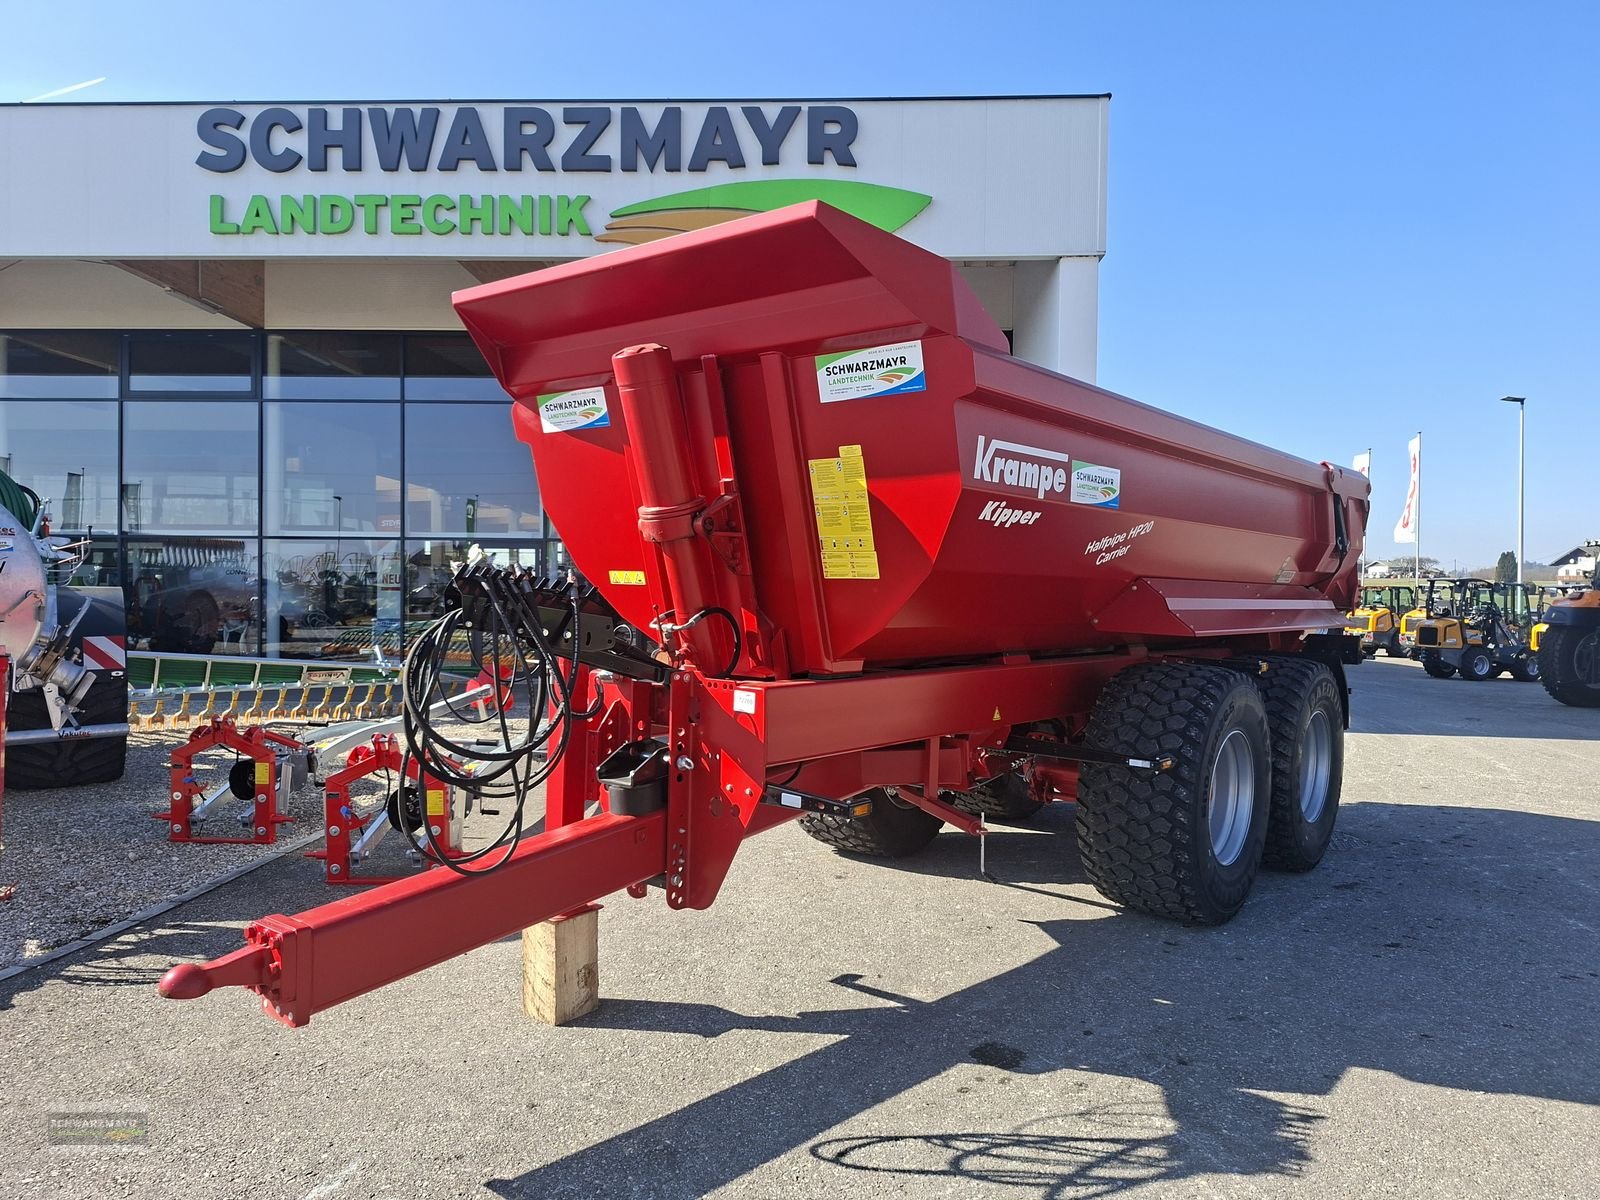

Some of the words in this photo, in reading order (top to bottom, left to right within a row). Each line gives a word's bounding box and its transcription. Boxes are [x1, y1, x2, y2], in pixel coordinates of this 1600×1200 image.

[195, 105, 859, 173] SCHWARZMAYR
[209, 194, 592, 236] LANDTECHNIK
[825, 355, 907, 376] SCHWARZMAYR
[828, 373, 875, 386] LANDTECHNIK
[545, 398, 597, 412] SCHWARZMAYR
[974, 435, 1068, 499] Krampe
[1076, 471, 1115, 486] SCHWARZMAYR
[978, 501, 1042, 528] Kipper
[1084, 533, 1127, 555] Halfpipe
[1127, 520, 1155, 540] HP20
[1096, 545, 1131, 565] Carrier
[58, 730, 92, 738] Vakutec
